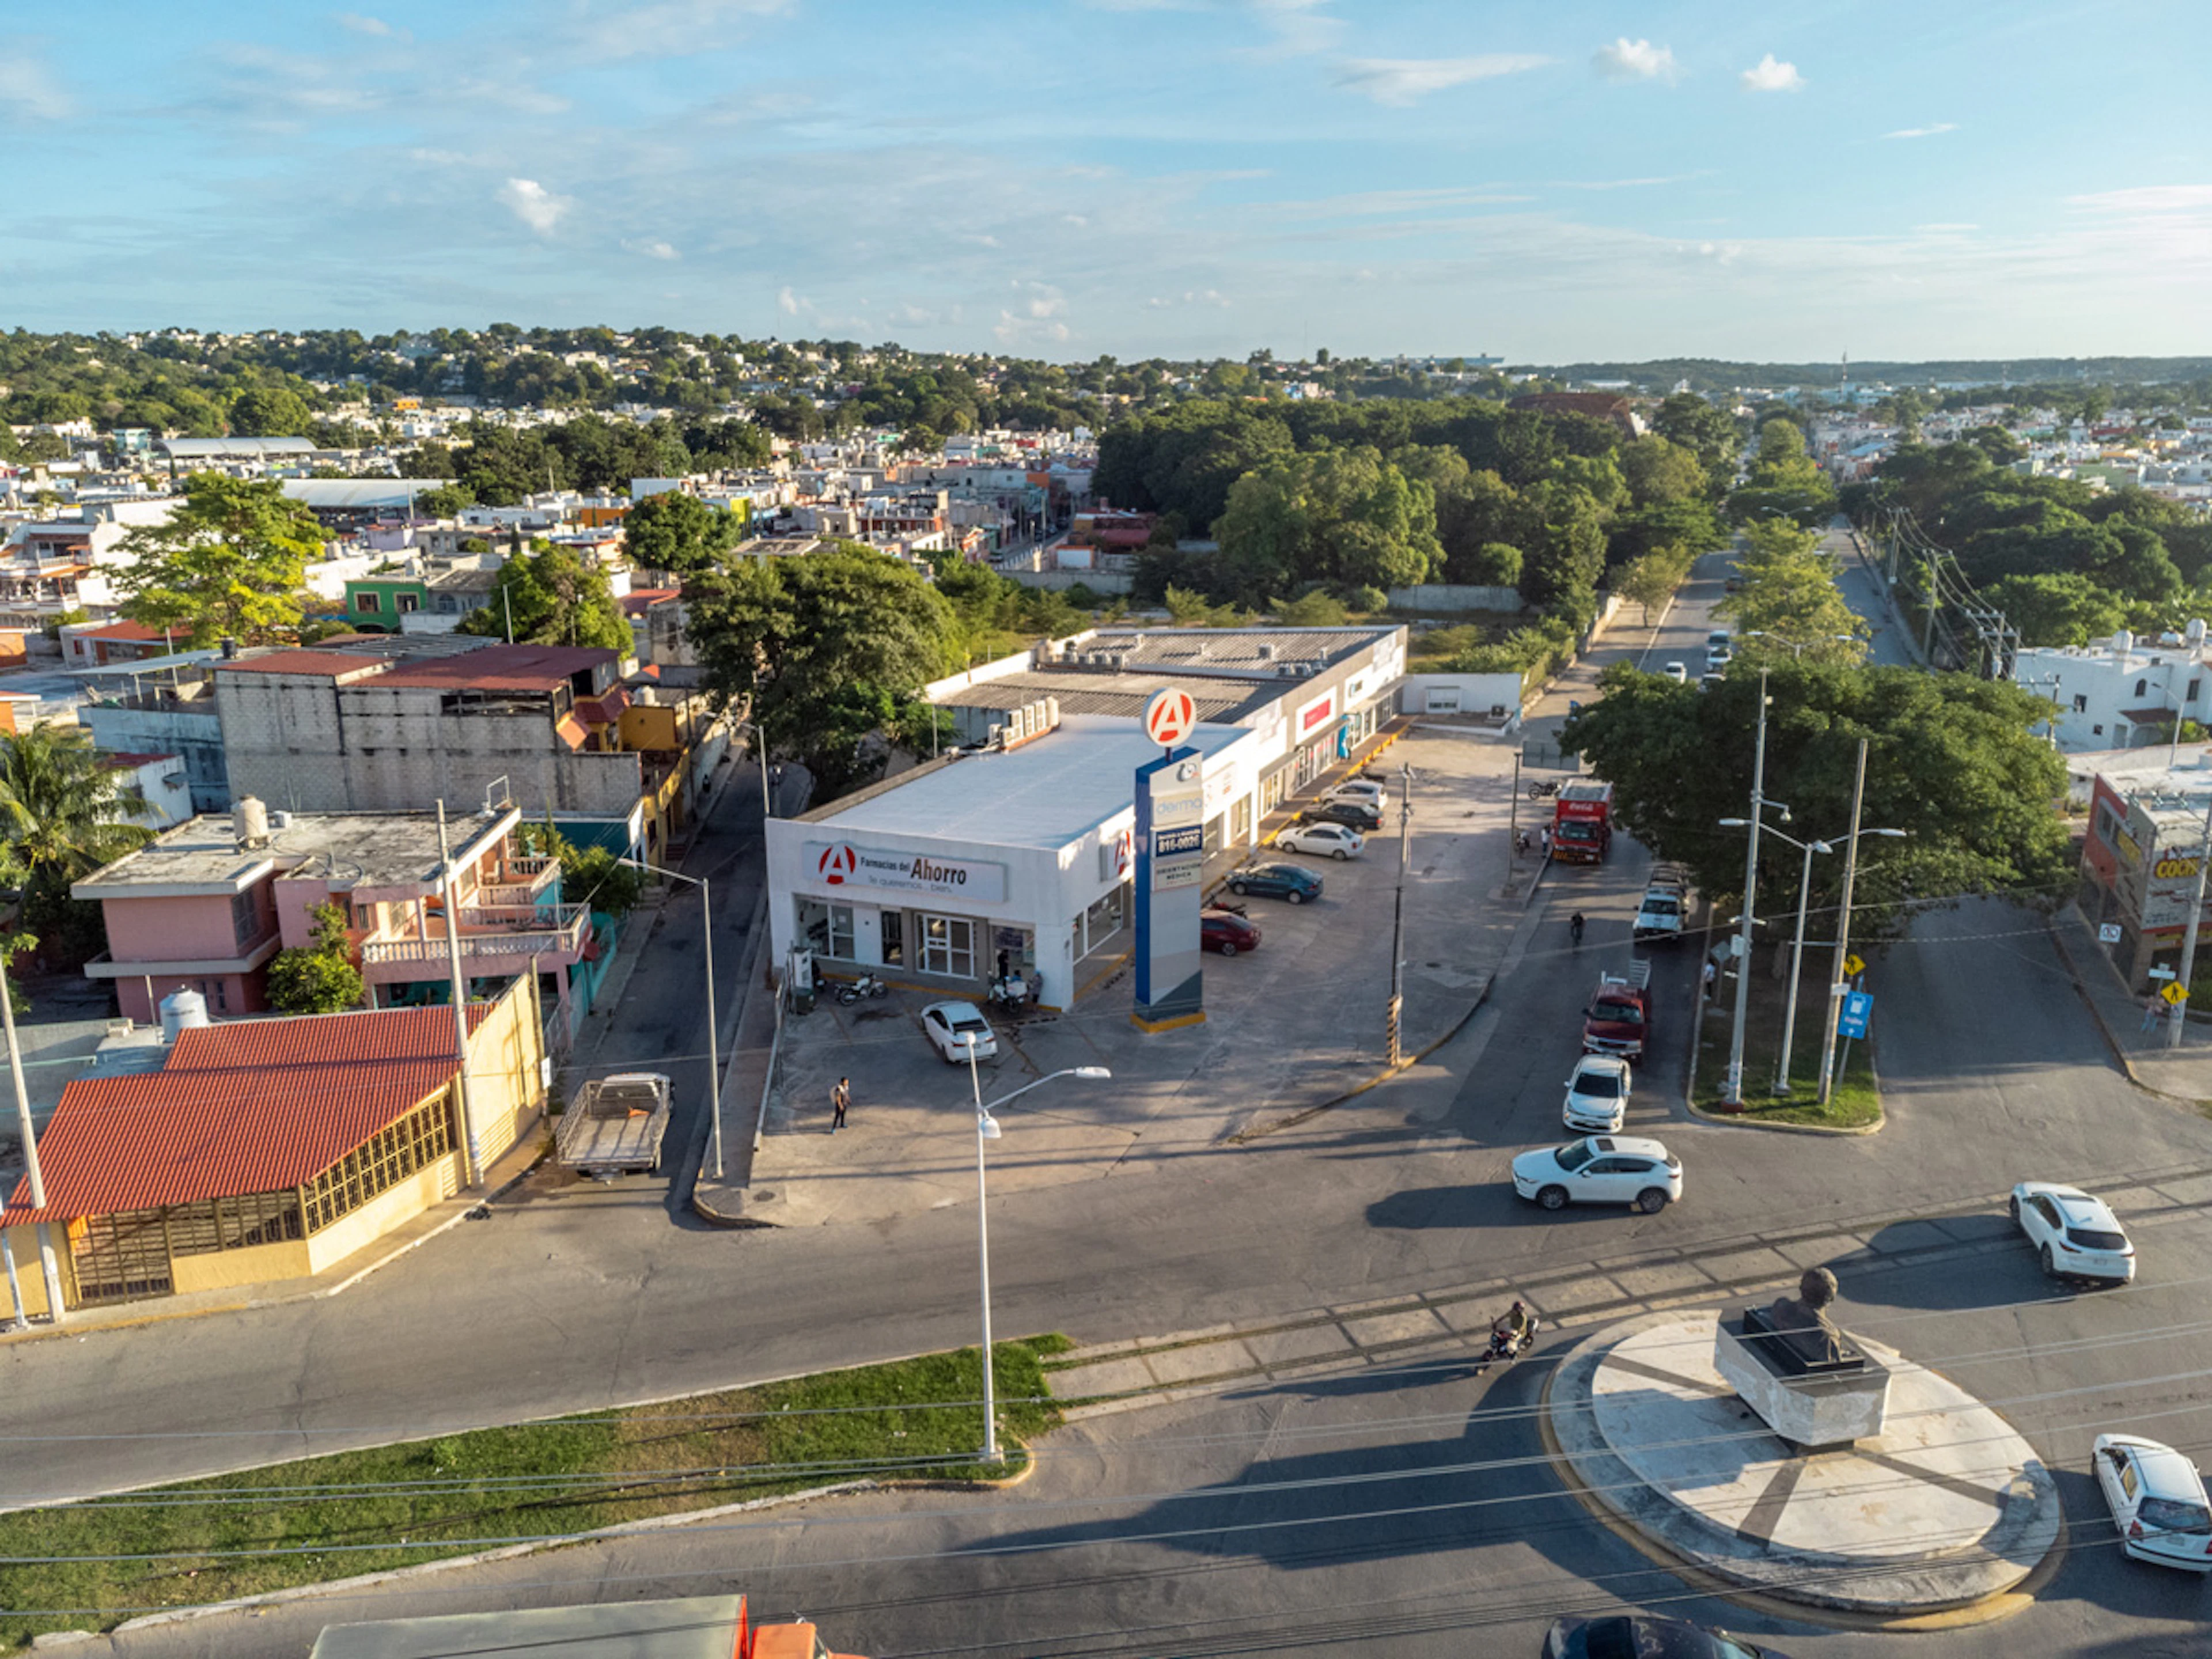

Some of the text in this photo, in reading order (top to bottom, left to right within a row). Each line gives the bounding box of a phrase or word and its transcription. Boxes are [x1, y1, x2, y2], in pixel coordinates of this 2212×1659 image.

[860, 857, 967, 885] Farmacias del Ahorro
